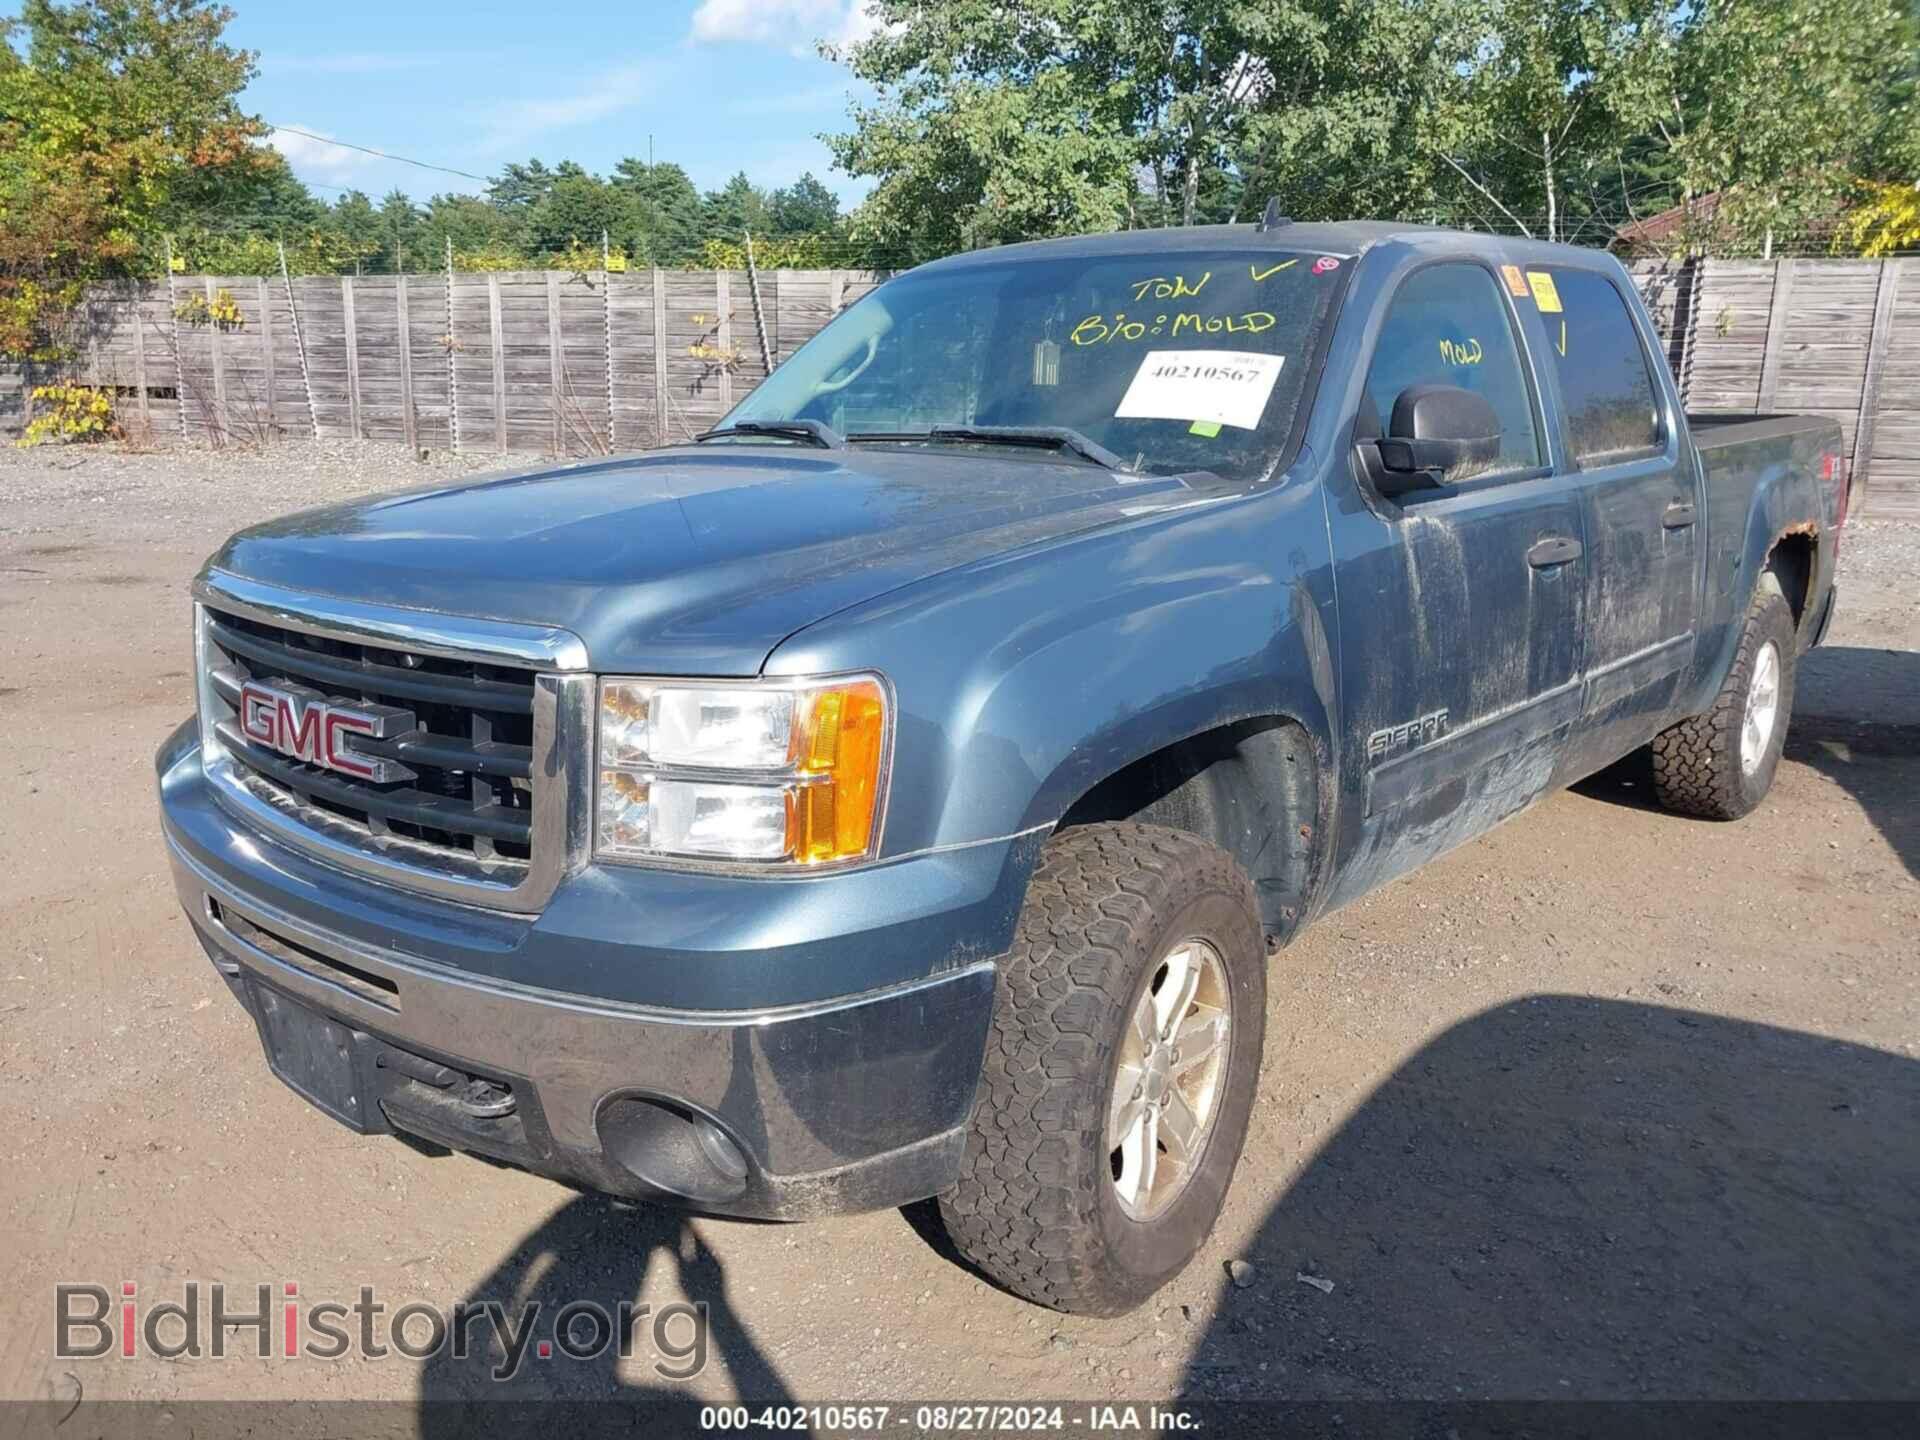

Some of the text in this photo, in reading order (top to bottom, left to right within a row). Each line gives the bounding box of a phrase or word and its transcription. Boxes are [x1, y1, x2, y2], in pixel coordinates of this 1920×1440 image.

[1131, 272, 1211, 301] TOW
[1439, 338, 1483, 366] MOLD
[1151, 364, 1261, 384] 40210567
[241, 681, 386, 784] GMC
